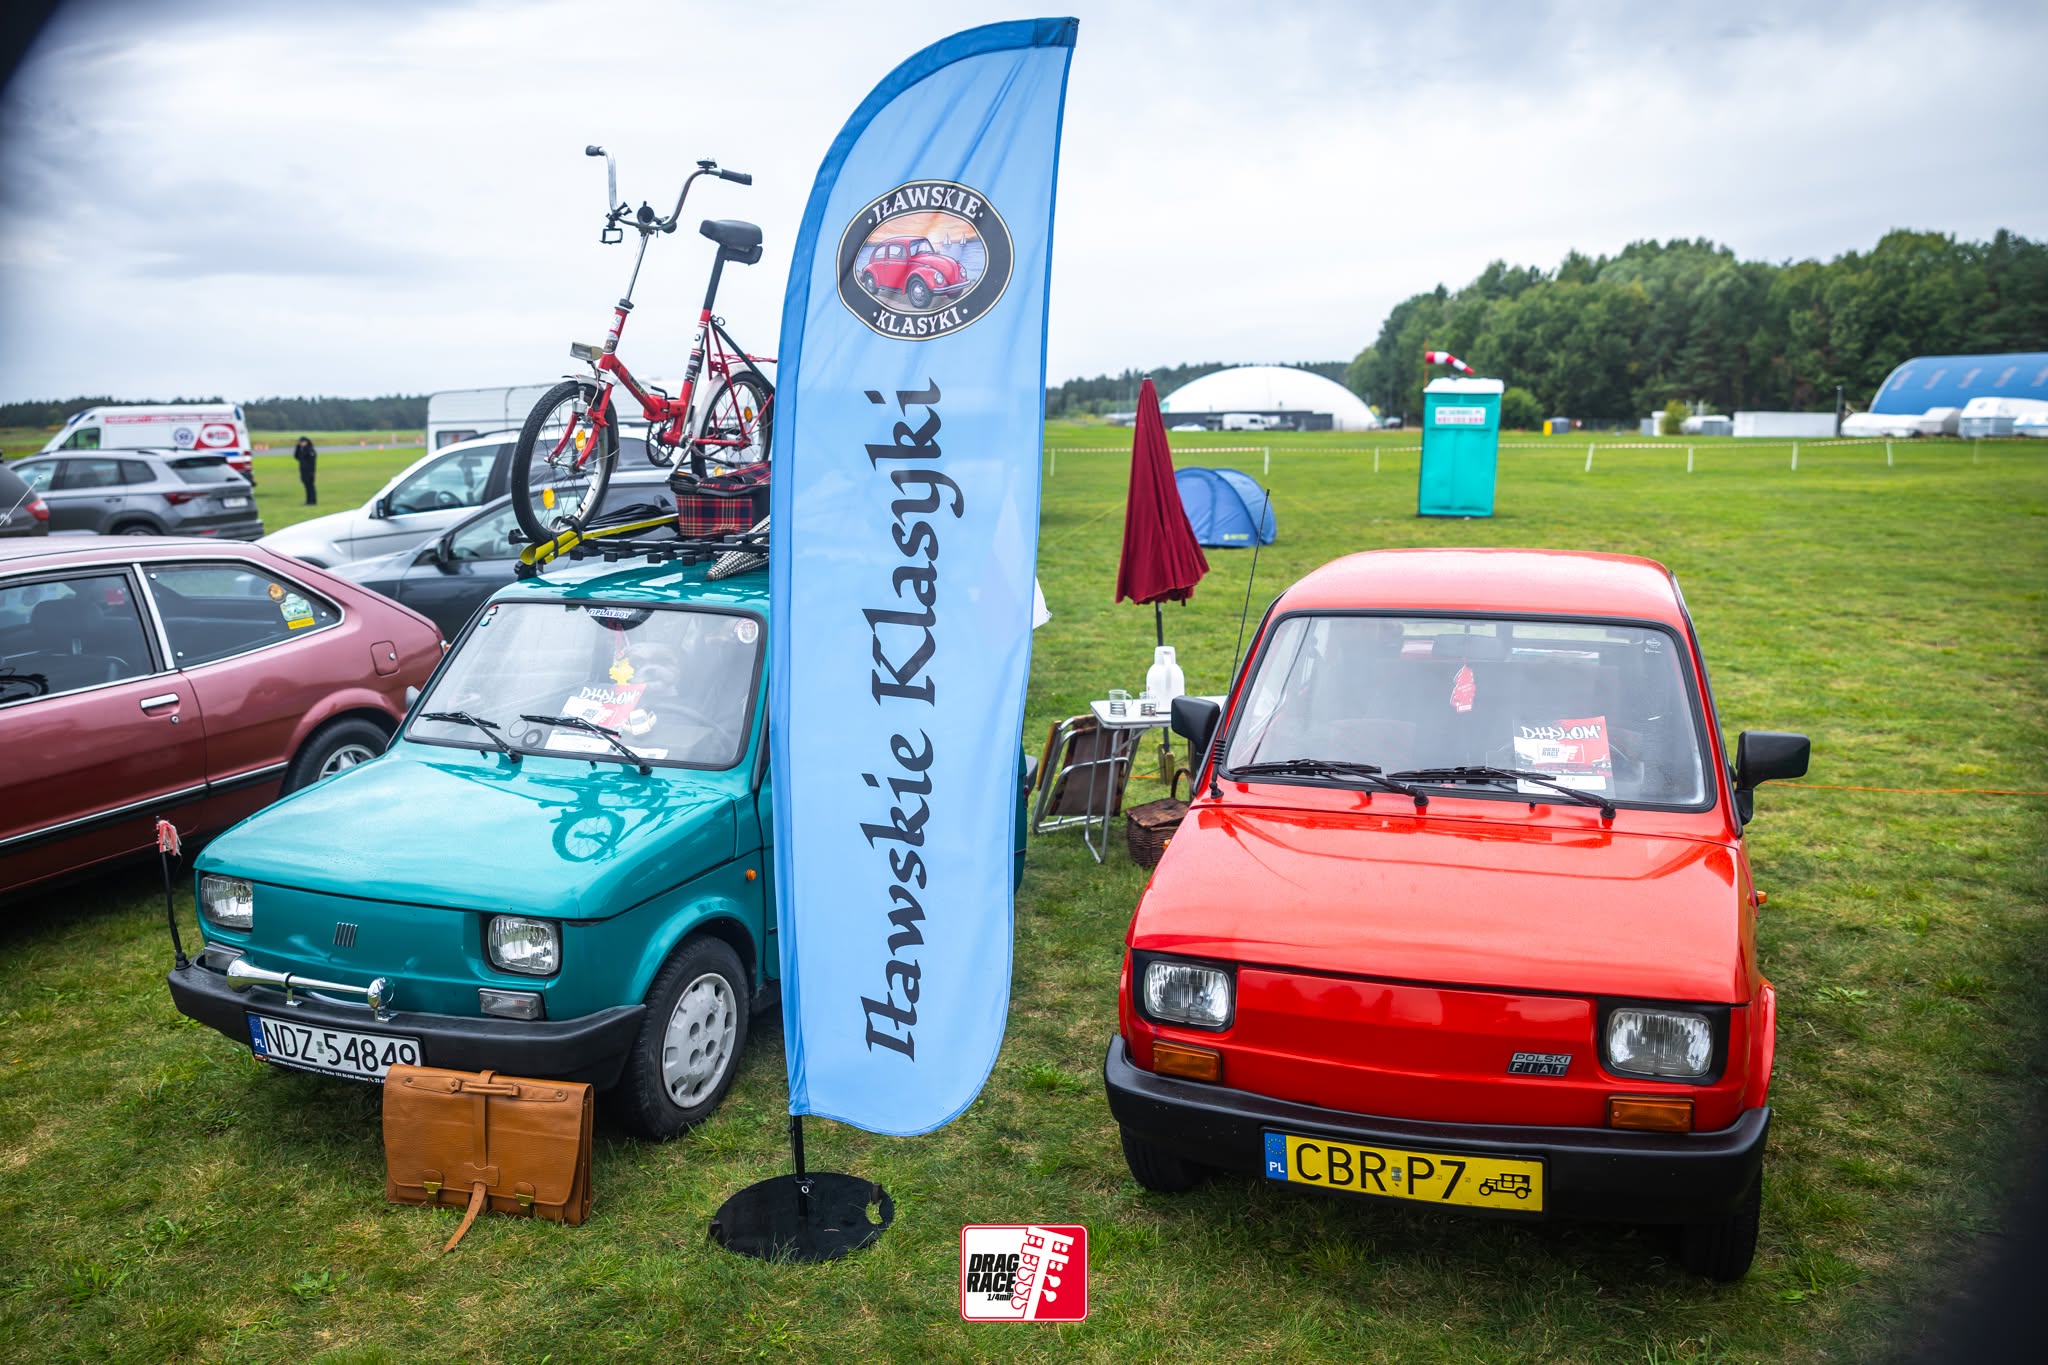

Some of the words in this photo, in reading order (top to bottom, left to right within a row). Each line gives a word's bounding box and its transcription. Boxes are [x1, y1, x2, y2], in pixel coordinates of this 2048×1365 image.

[872, 186, 982, 224] IŁAWSKIE
[876, 306, 962, 335] KLASYKI
[861, 376, 965, 707] Klasyki
[254, 1037, 265, 1049] PL
[262, 1021, 318, 1063] NDZ
[1512, 1062, 1568, 1075] FIAT
[1514, 1053, 1569, 1064] POLSKI
[1269, 1161, 1285, 1174] PL
[1296, 1142, 1387, 1192] CBR
[1407, 1156, 1467, 1200] P7
